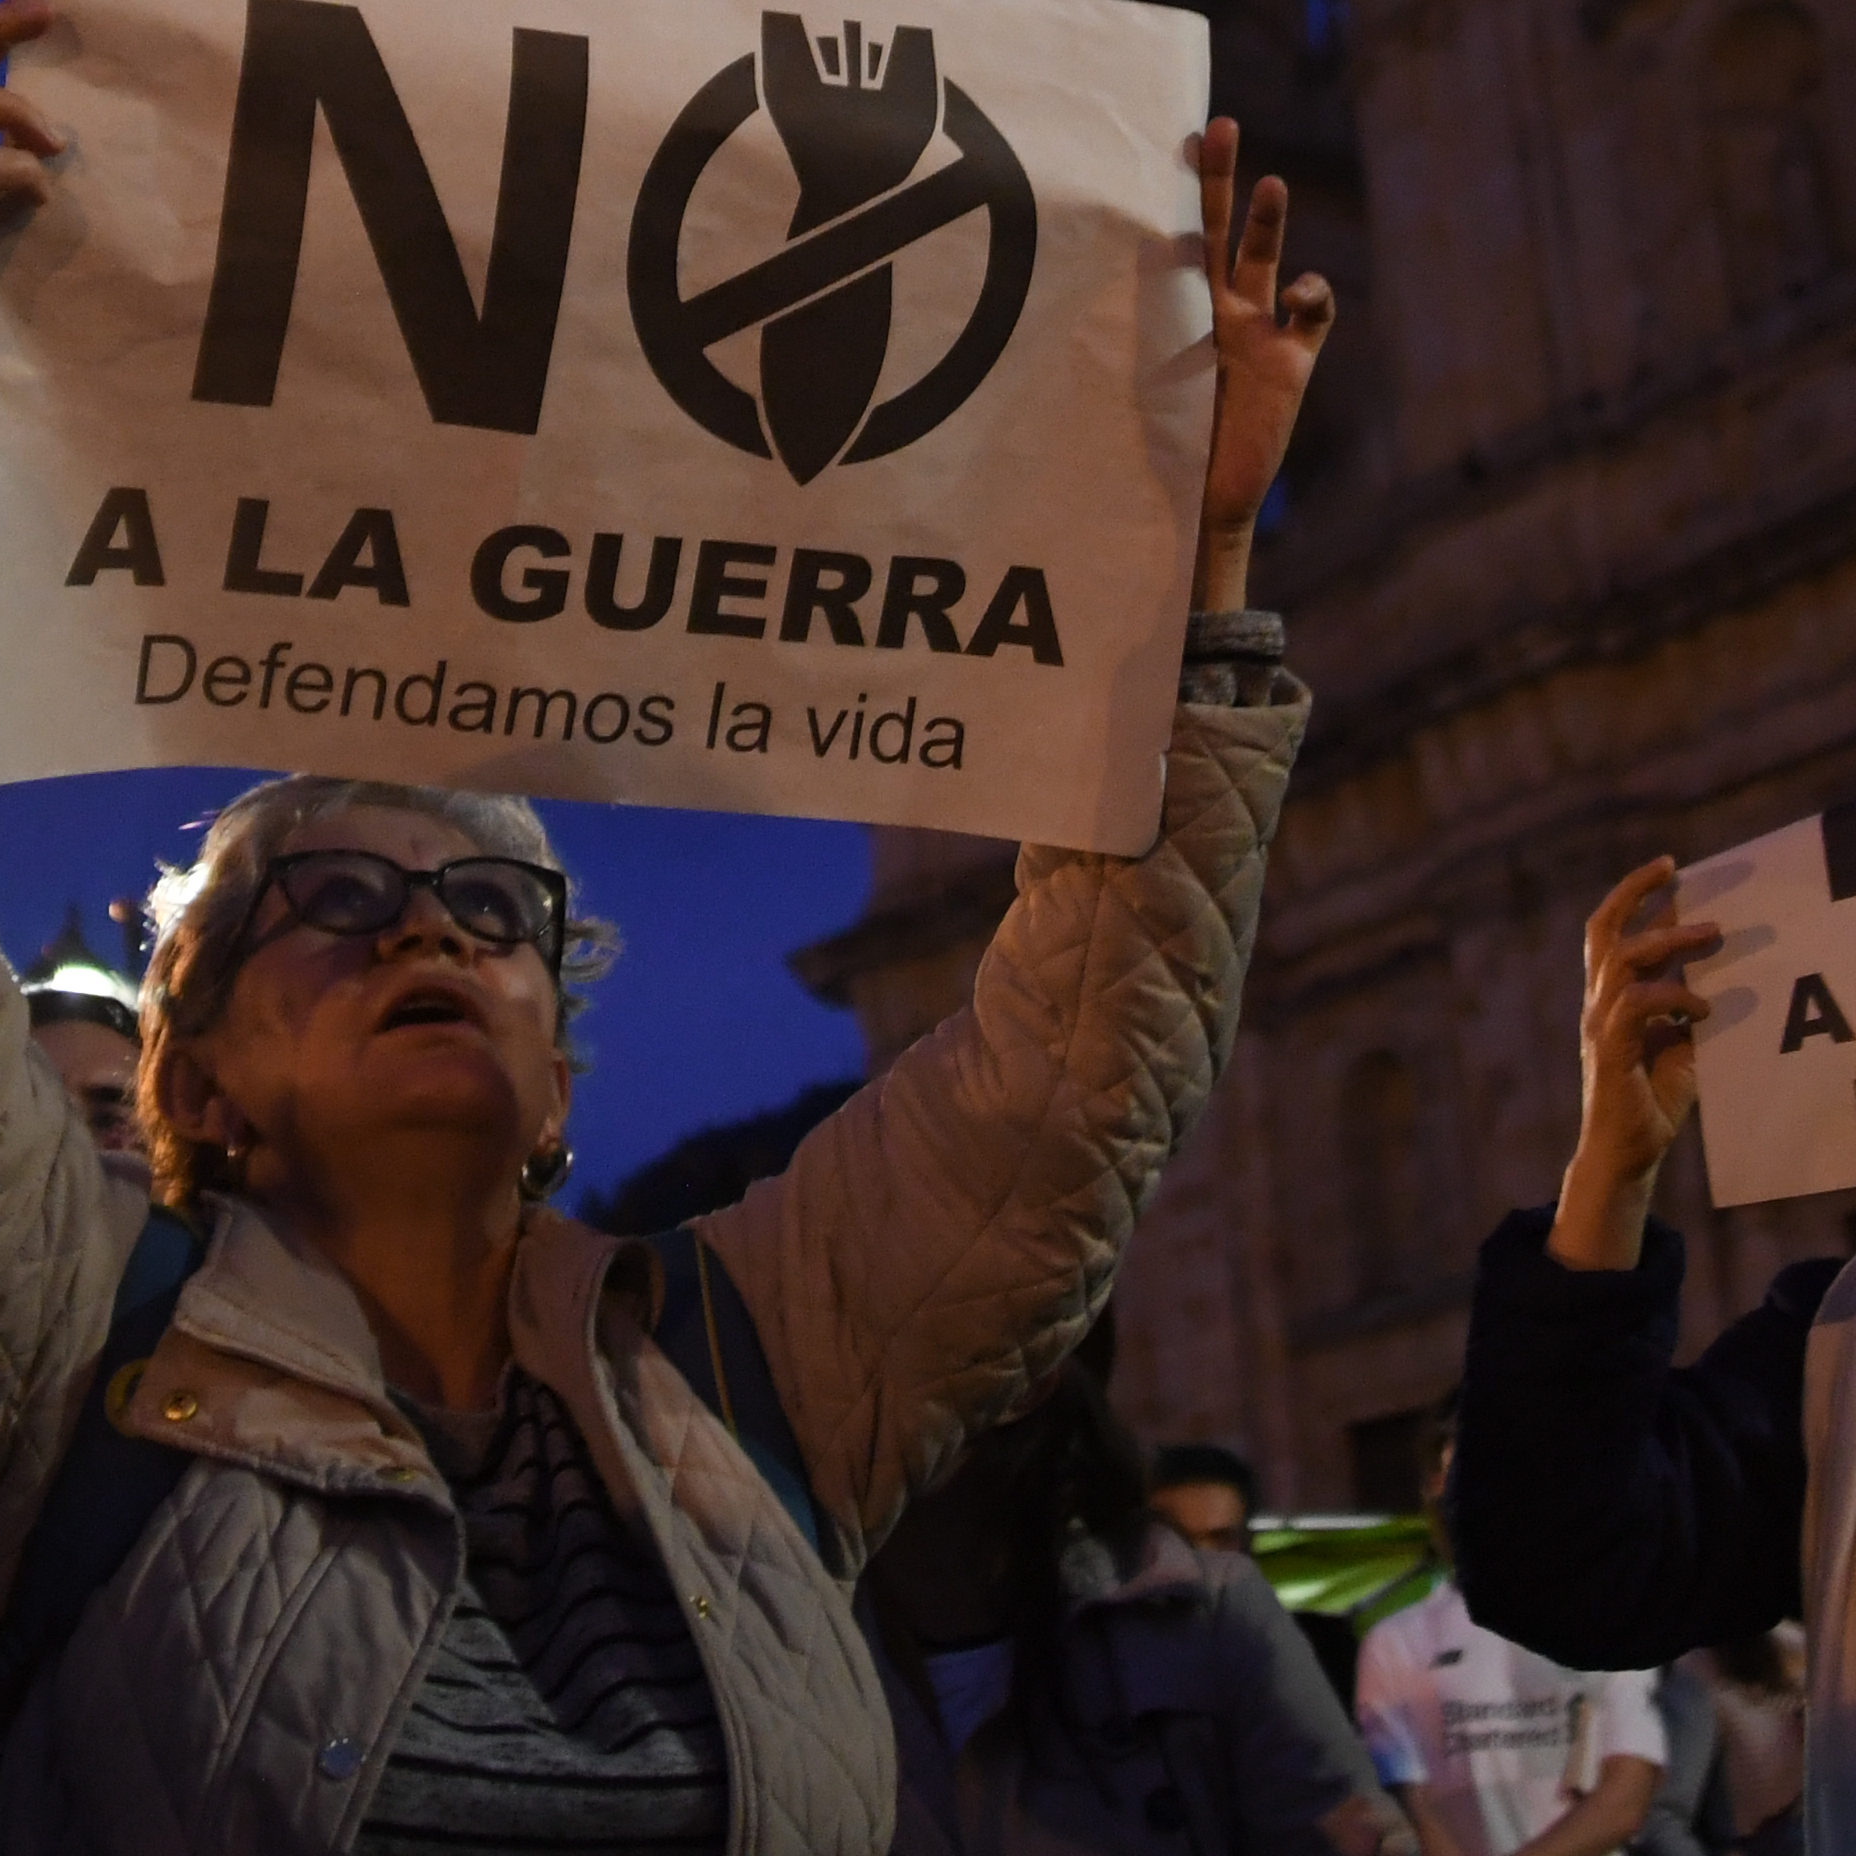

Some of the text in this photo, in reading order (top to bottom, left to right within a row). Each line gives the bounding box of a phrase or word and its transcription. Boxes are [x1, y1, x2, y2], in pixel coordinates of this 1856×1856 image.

[67, 487, 1063, 666] A LA GUERRA
[135, 635, 965, 769] Defendamos la vida
[1780, 974, 1855, 1054] A
